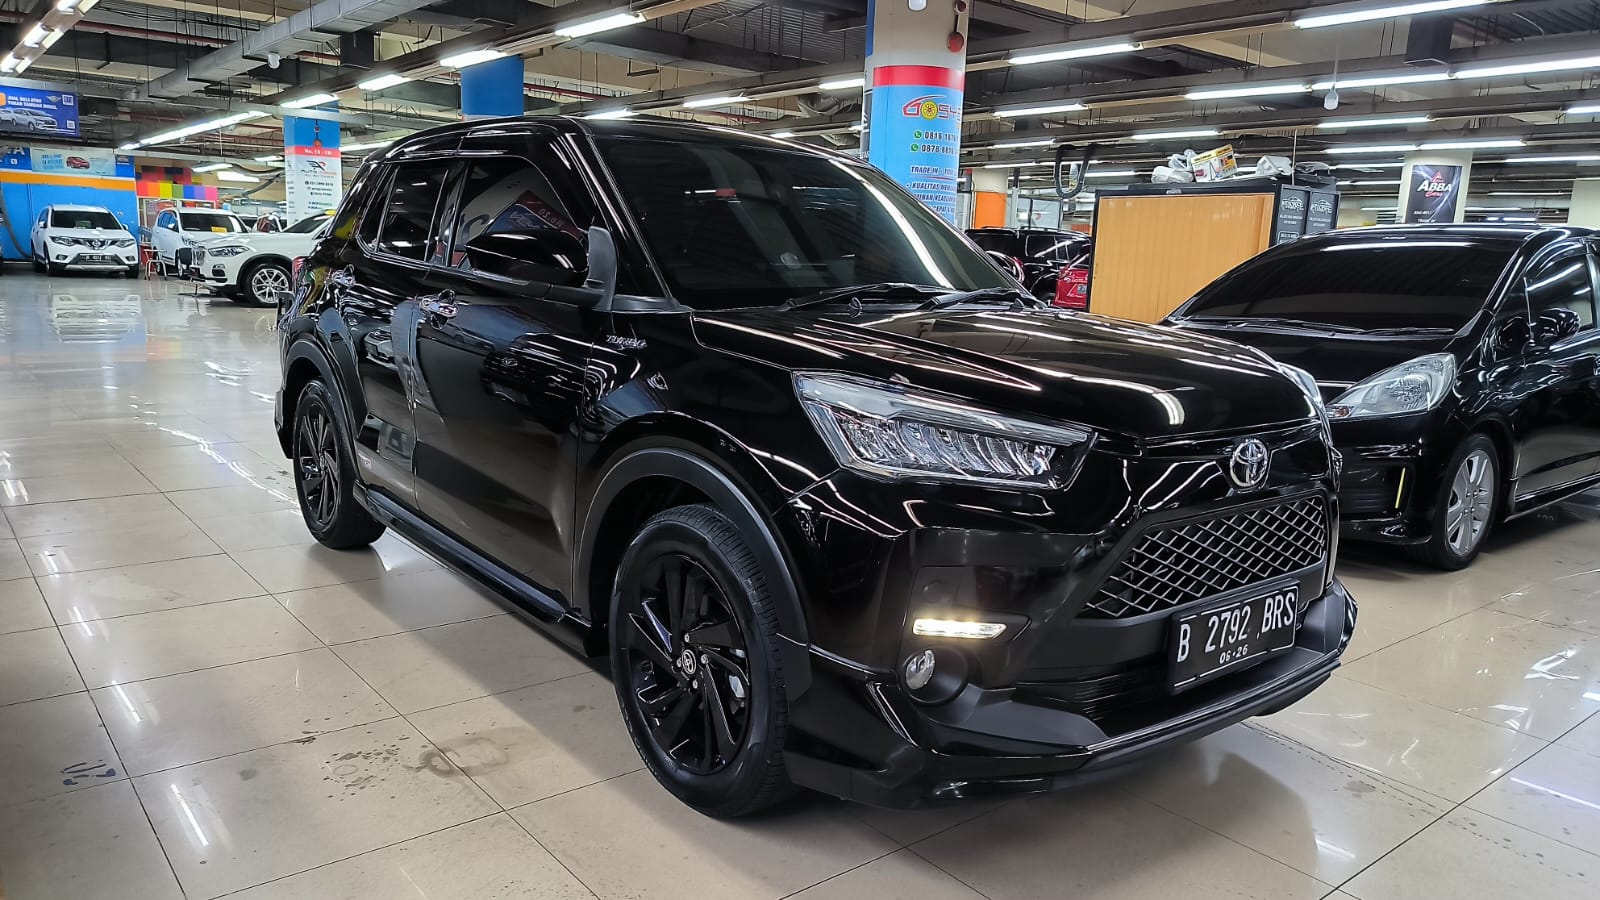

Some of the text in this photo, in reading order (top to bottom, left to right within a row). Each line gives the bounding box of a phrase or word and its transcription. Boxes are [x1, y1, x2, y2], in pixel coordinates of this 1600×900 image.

[1417, 180, 1453, 192] ABBA
[1177, 592, 1295, 663] B 2792 BRS
